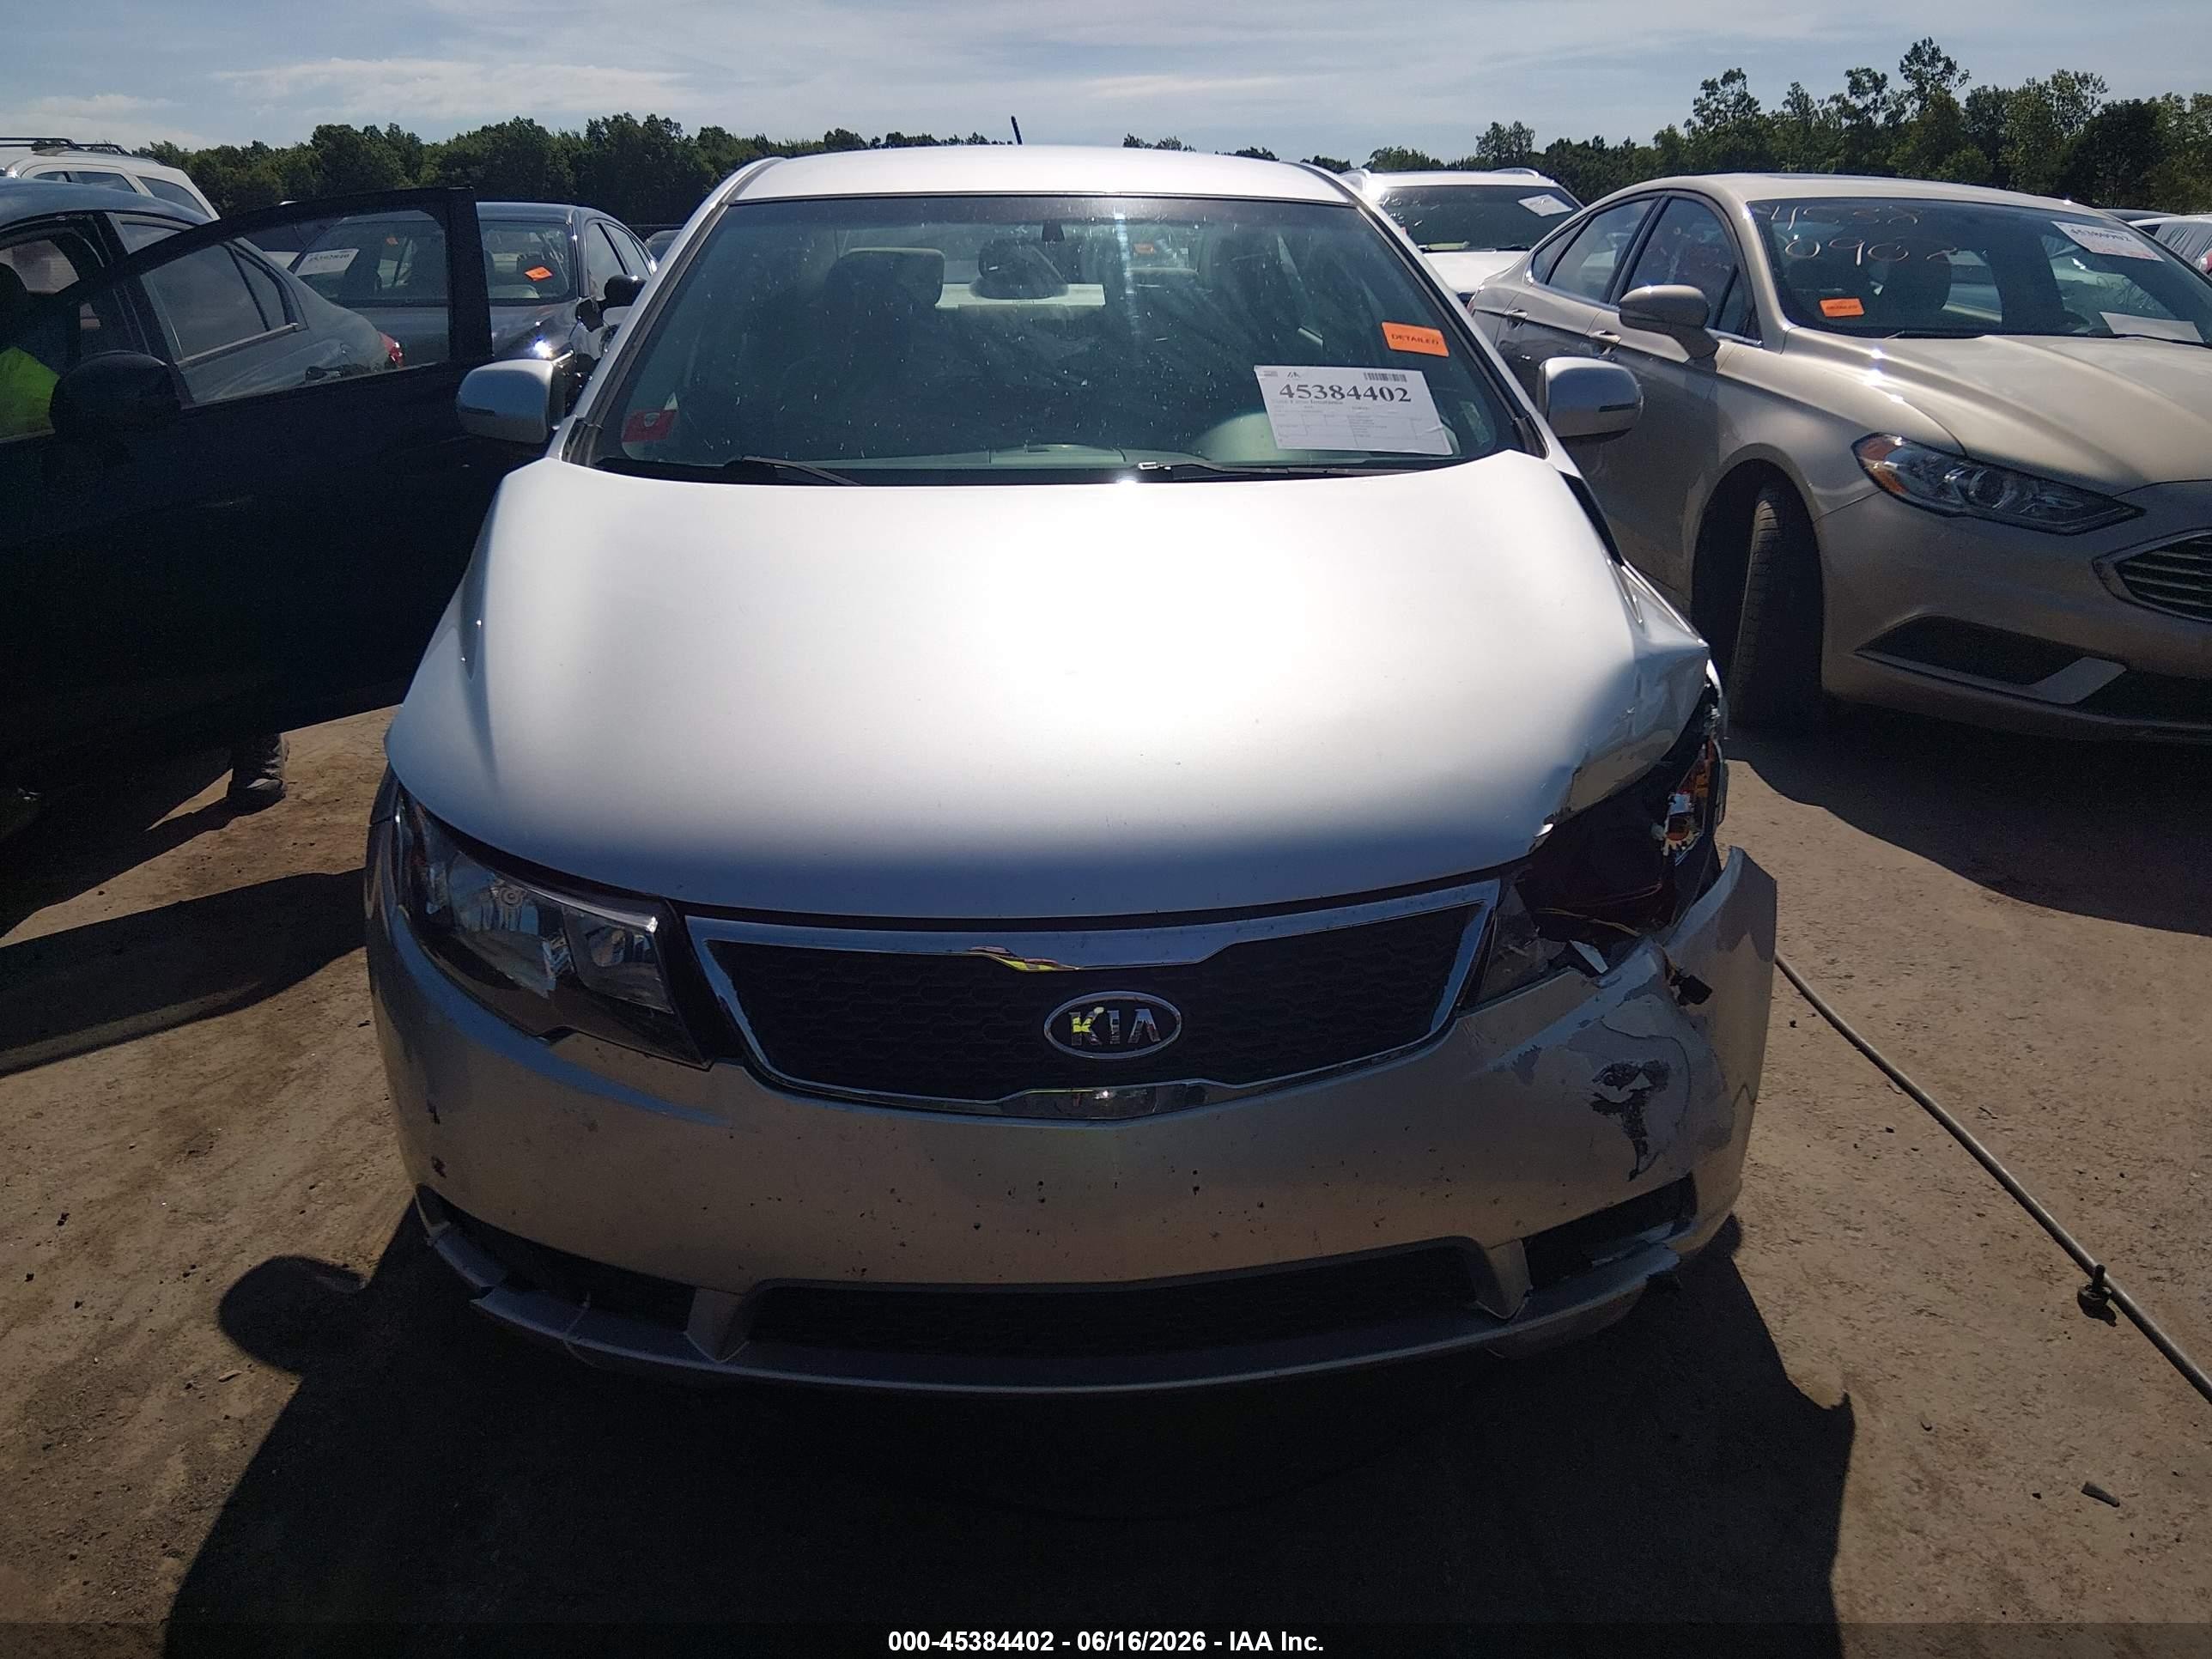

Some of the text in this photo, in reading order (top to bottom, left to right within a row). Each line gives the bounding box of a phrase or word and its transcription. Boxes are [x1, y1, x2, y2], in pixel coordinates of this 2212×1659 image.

[1391, 332, 1439, 344] DETAILED
[1279, 384, 1412, 403] 45384402
[1068, 1006, 1161, 1046] KIA
